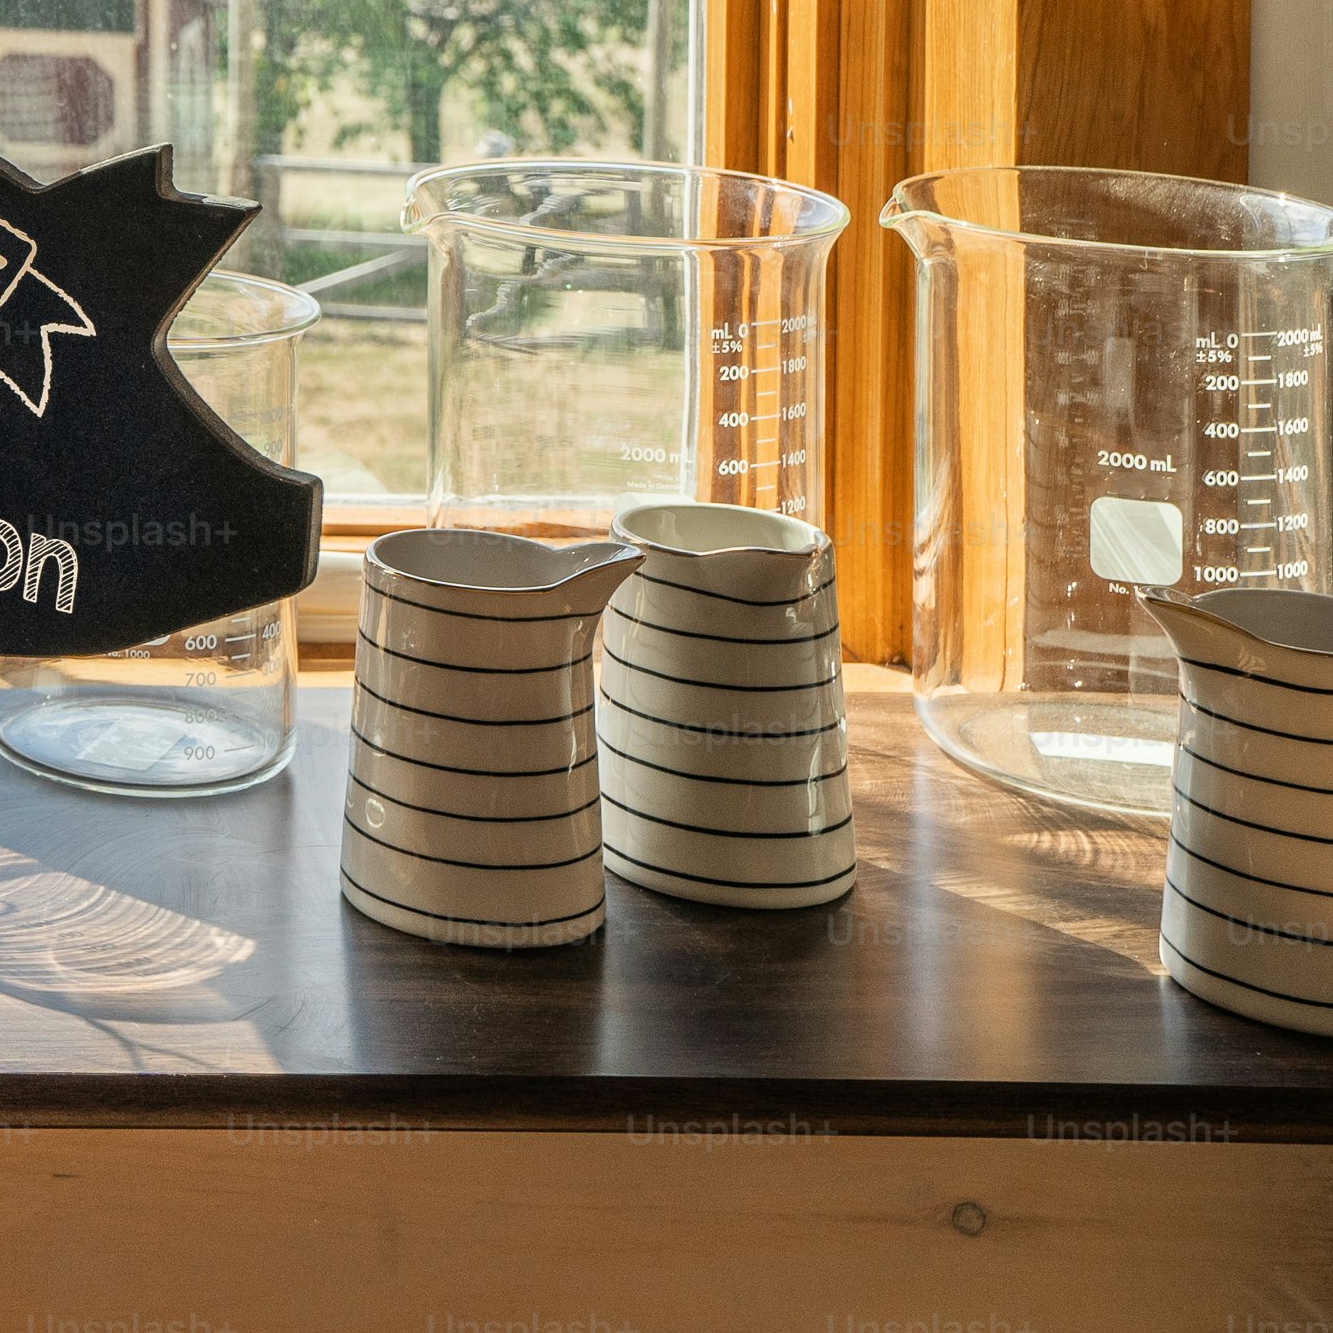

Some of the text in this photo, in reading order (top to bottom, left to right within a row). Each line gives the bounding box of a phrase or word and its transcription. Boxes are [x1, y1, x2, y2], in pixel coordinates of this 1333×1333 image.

[711, 323, 733, 339] mL
[739, 324, 749, 339] 0
[782, 318, 807, 333] 2000
[1196, 332, 1220, 349] mL
[1227, 332, 1239, 349] 0
[1276, 328, 1309, 347] 2000
[711, 342, 743, 353] ±5%
[1196, 350, 1232, 363] ±5%
[720, 356, 806, 380] 200 1800
[1205, 370, 1309, 391] 200 1800
[719, 402, 806, 427] 400 1600
[1204, 417, 1309, 439] 400 1600
[621, 447, 665, 462] 2000
[719, 450, 806, 475] 600 1400
[1097, 450, 1177, 472] 2000 mL
[1204, 465, 1309, 486] 600 1400
[781, 498, 806, 514] 1200
[1205, 513, 1309, 535] 800 1200
[1194, 561, 1309, 582] 1000 1000
[1109, 583, 1130, 596] No.
[185, 622, 282, 650] 600 400
[125, 649, 150, 659] 1000
[185, 672, 216, 688] 700
[185, 709, 216, 724] 800
[184, 746, 215, 760] 900
